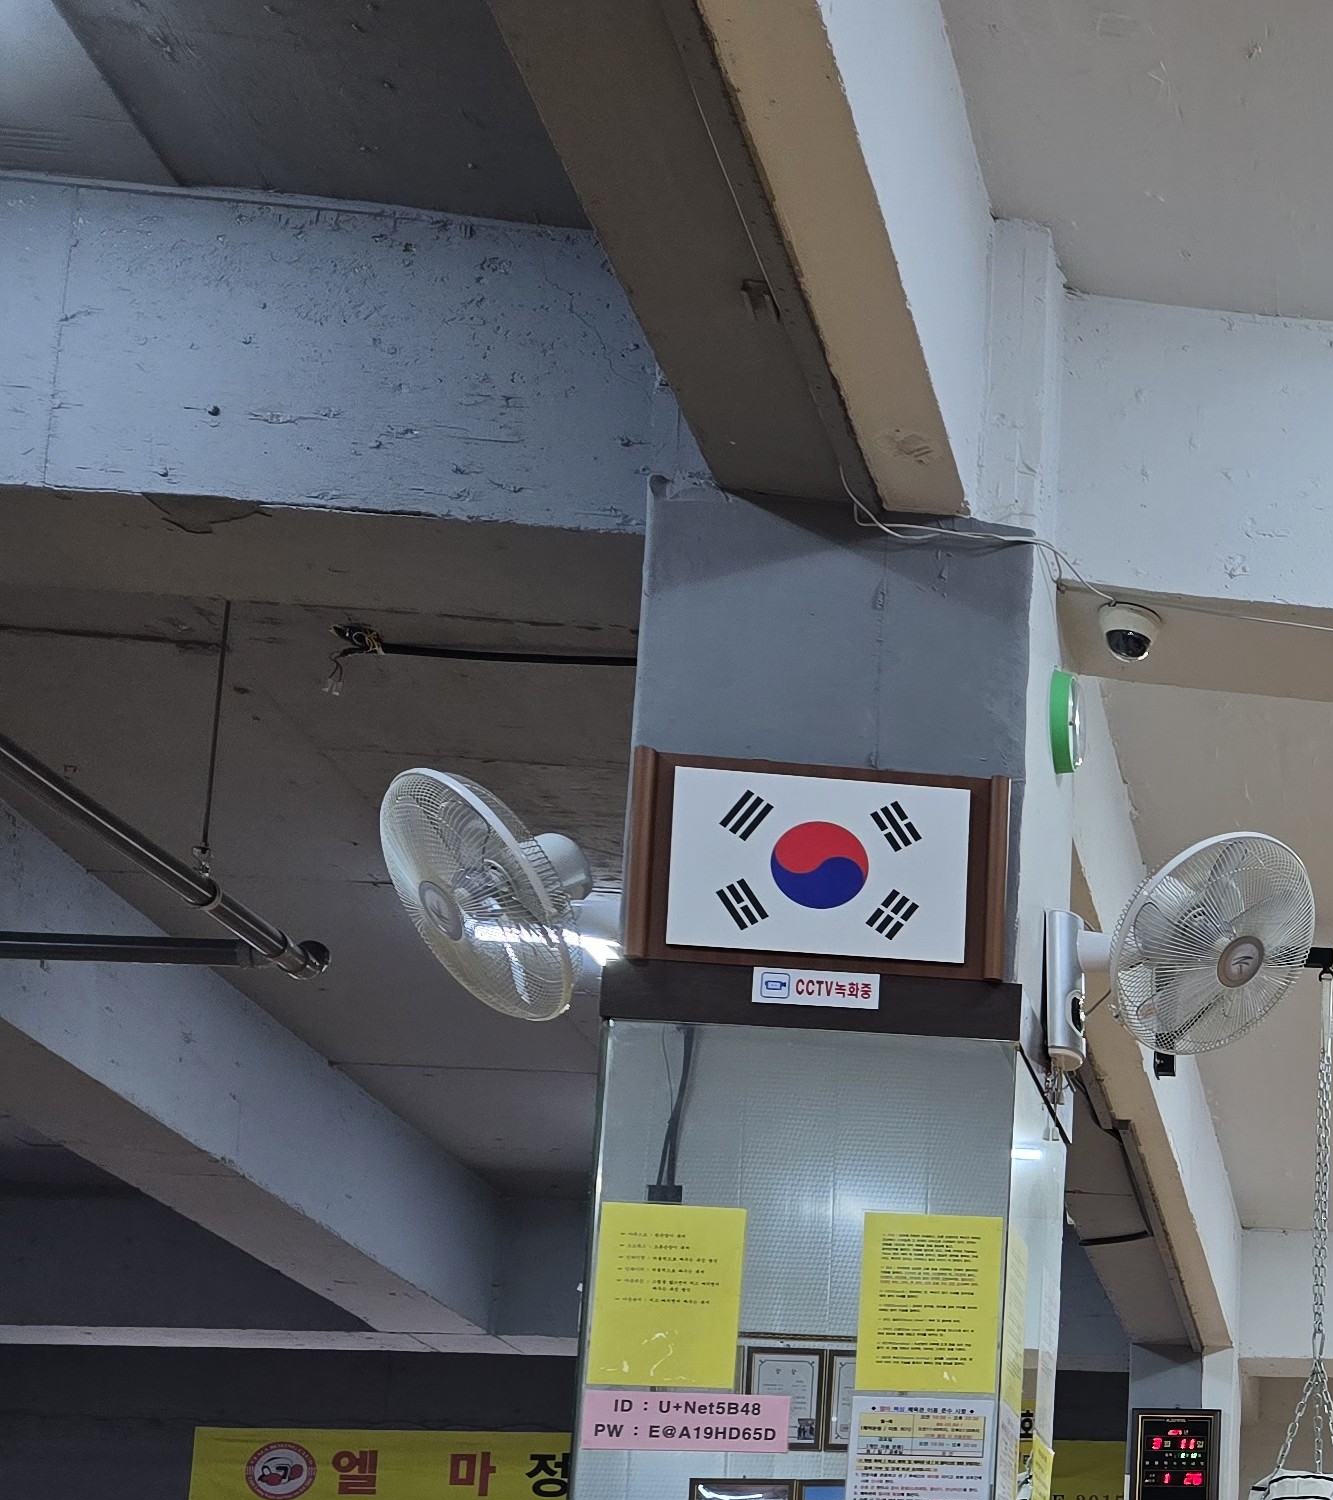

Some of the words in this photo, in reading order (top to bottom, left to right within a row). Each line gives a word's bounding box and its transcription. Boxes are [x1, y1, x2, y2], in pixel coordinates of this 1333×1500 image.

[795, 978, 873, 1000] CCTV녹화중
[613, 1398, 634, 1413] ID
[658, 1400, 762, 1416] U+Net5B48
[593, 1423, 625, 1438] PW
[648, 1425, 777, 1441] E@A19HD65D
[331, 1449, 380, 1496] 엘
[448, 1451, 498, 1498] 마
